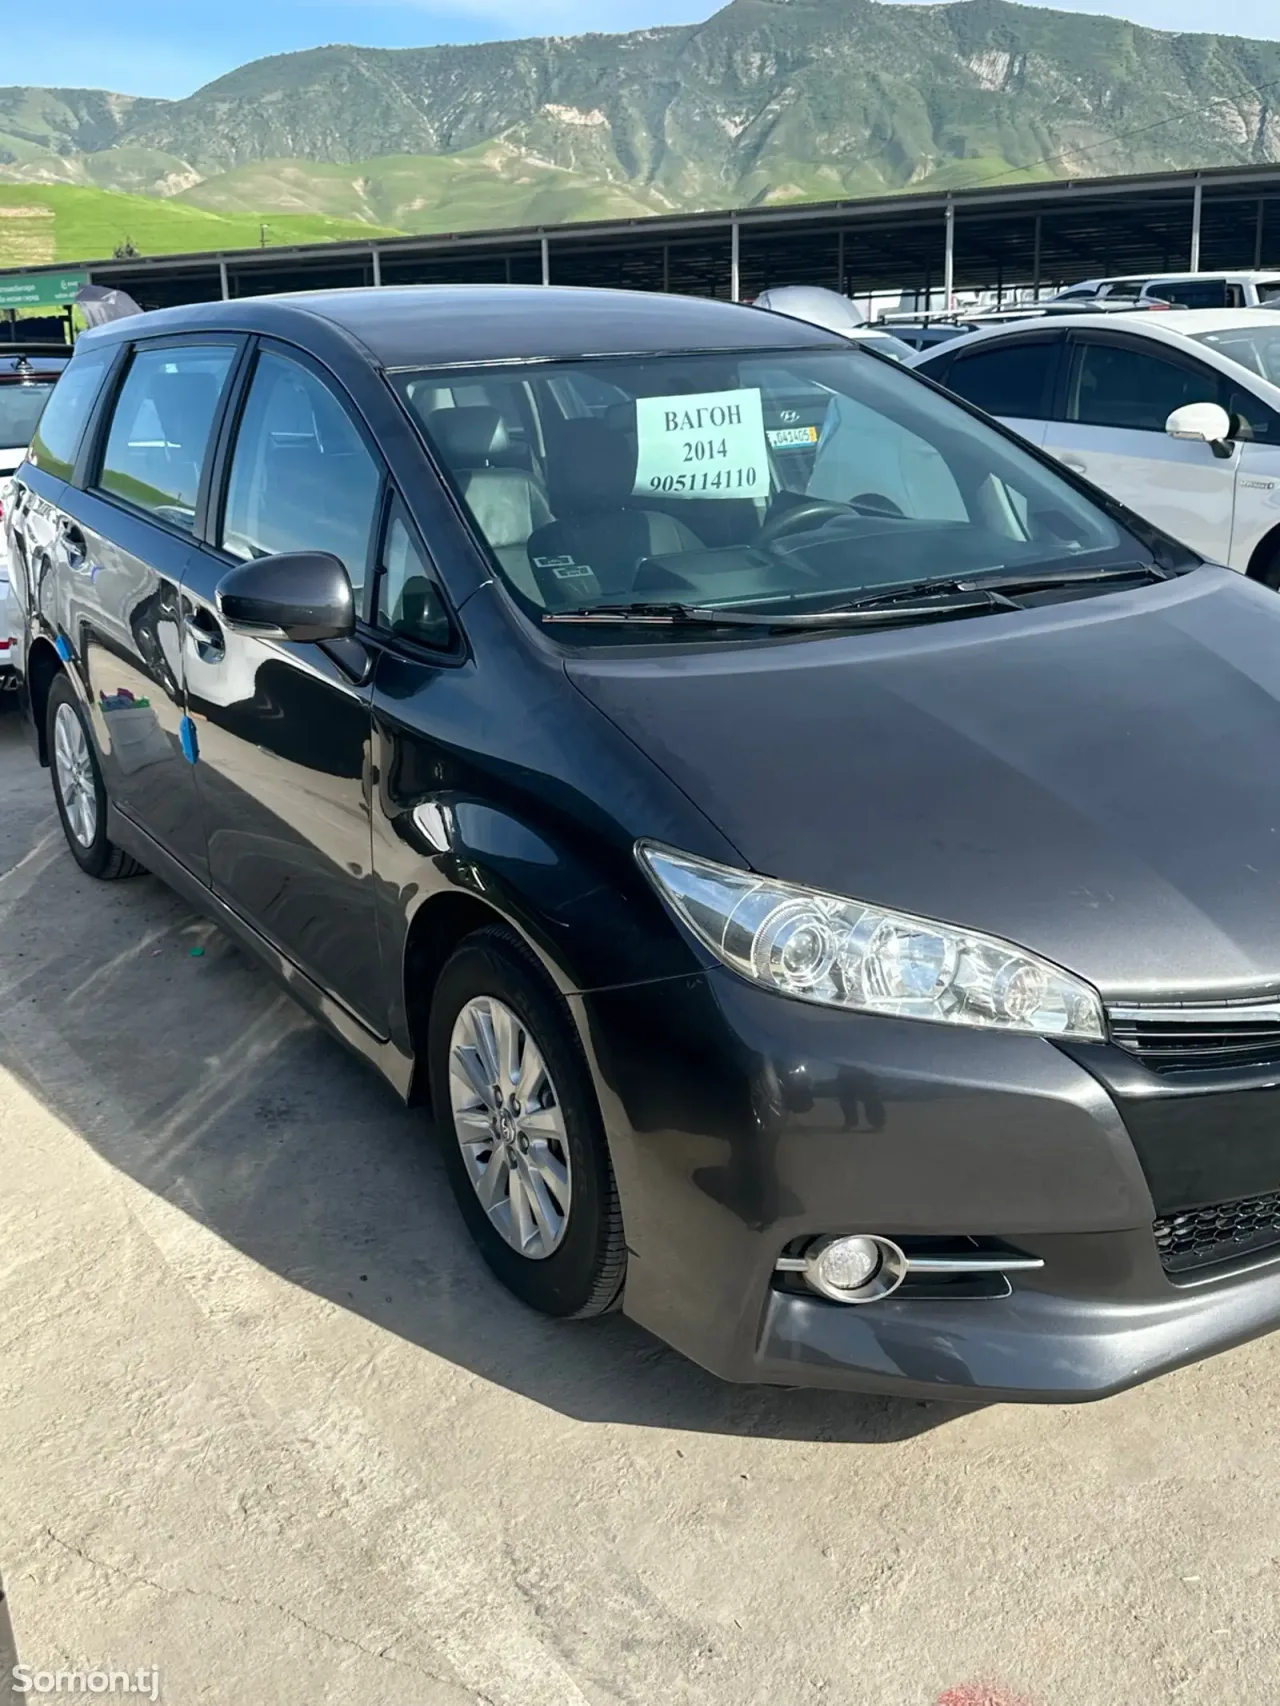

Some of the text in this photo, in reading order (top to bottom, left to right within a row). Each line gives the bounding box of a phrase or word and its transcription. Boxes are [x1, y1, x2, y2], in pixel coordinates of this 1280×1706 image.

[664, 404, 742, 432] ВАГОН
[683, 438, 728, 463] 2014
[650, 466, 757, 492] 905114110
